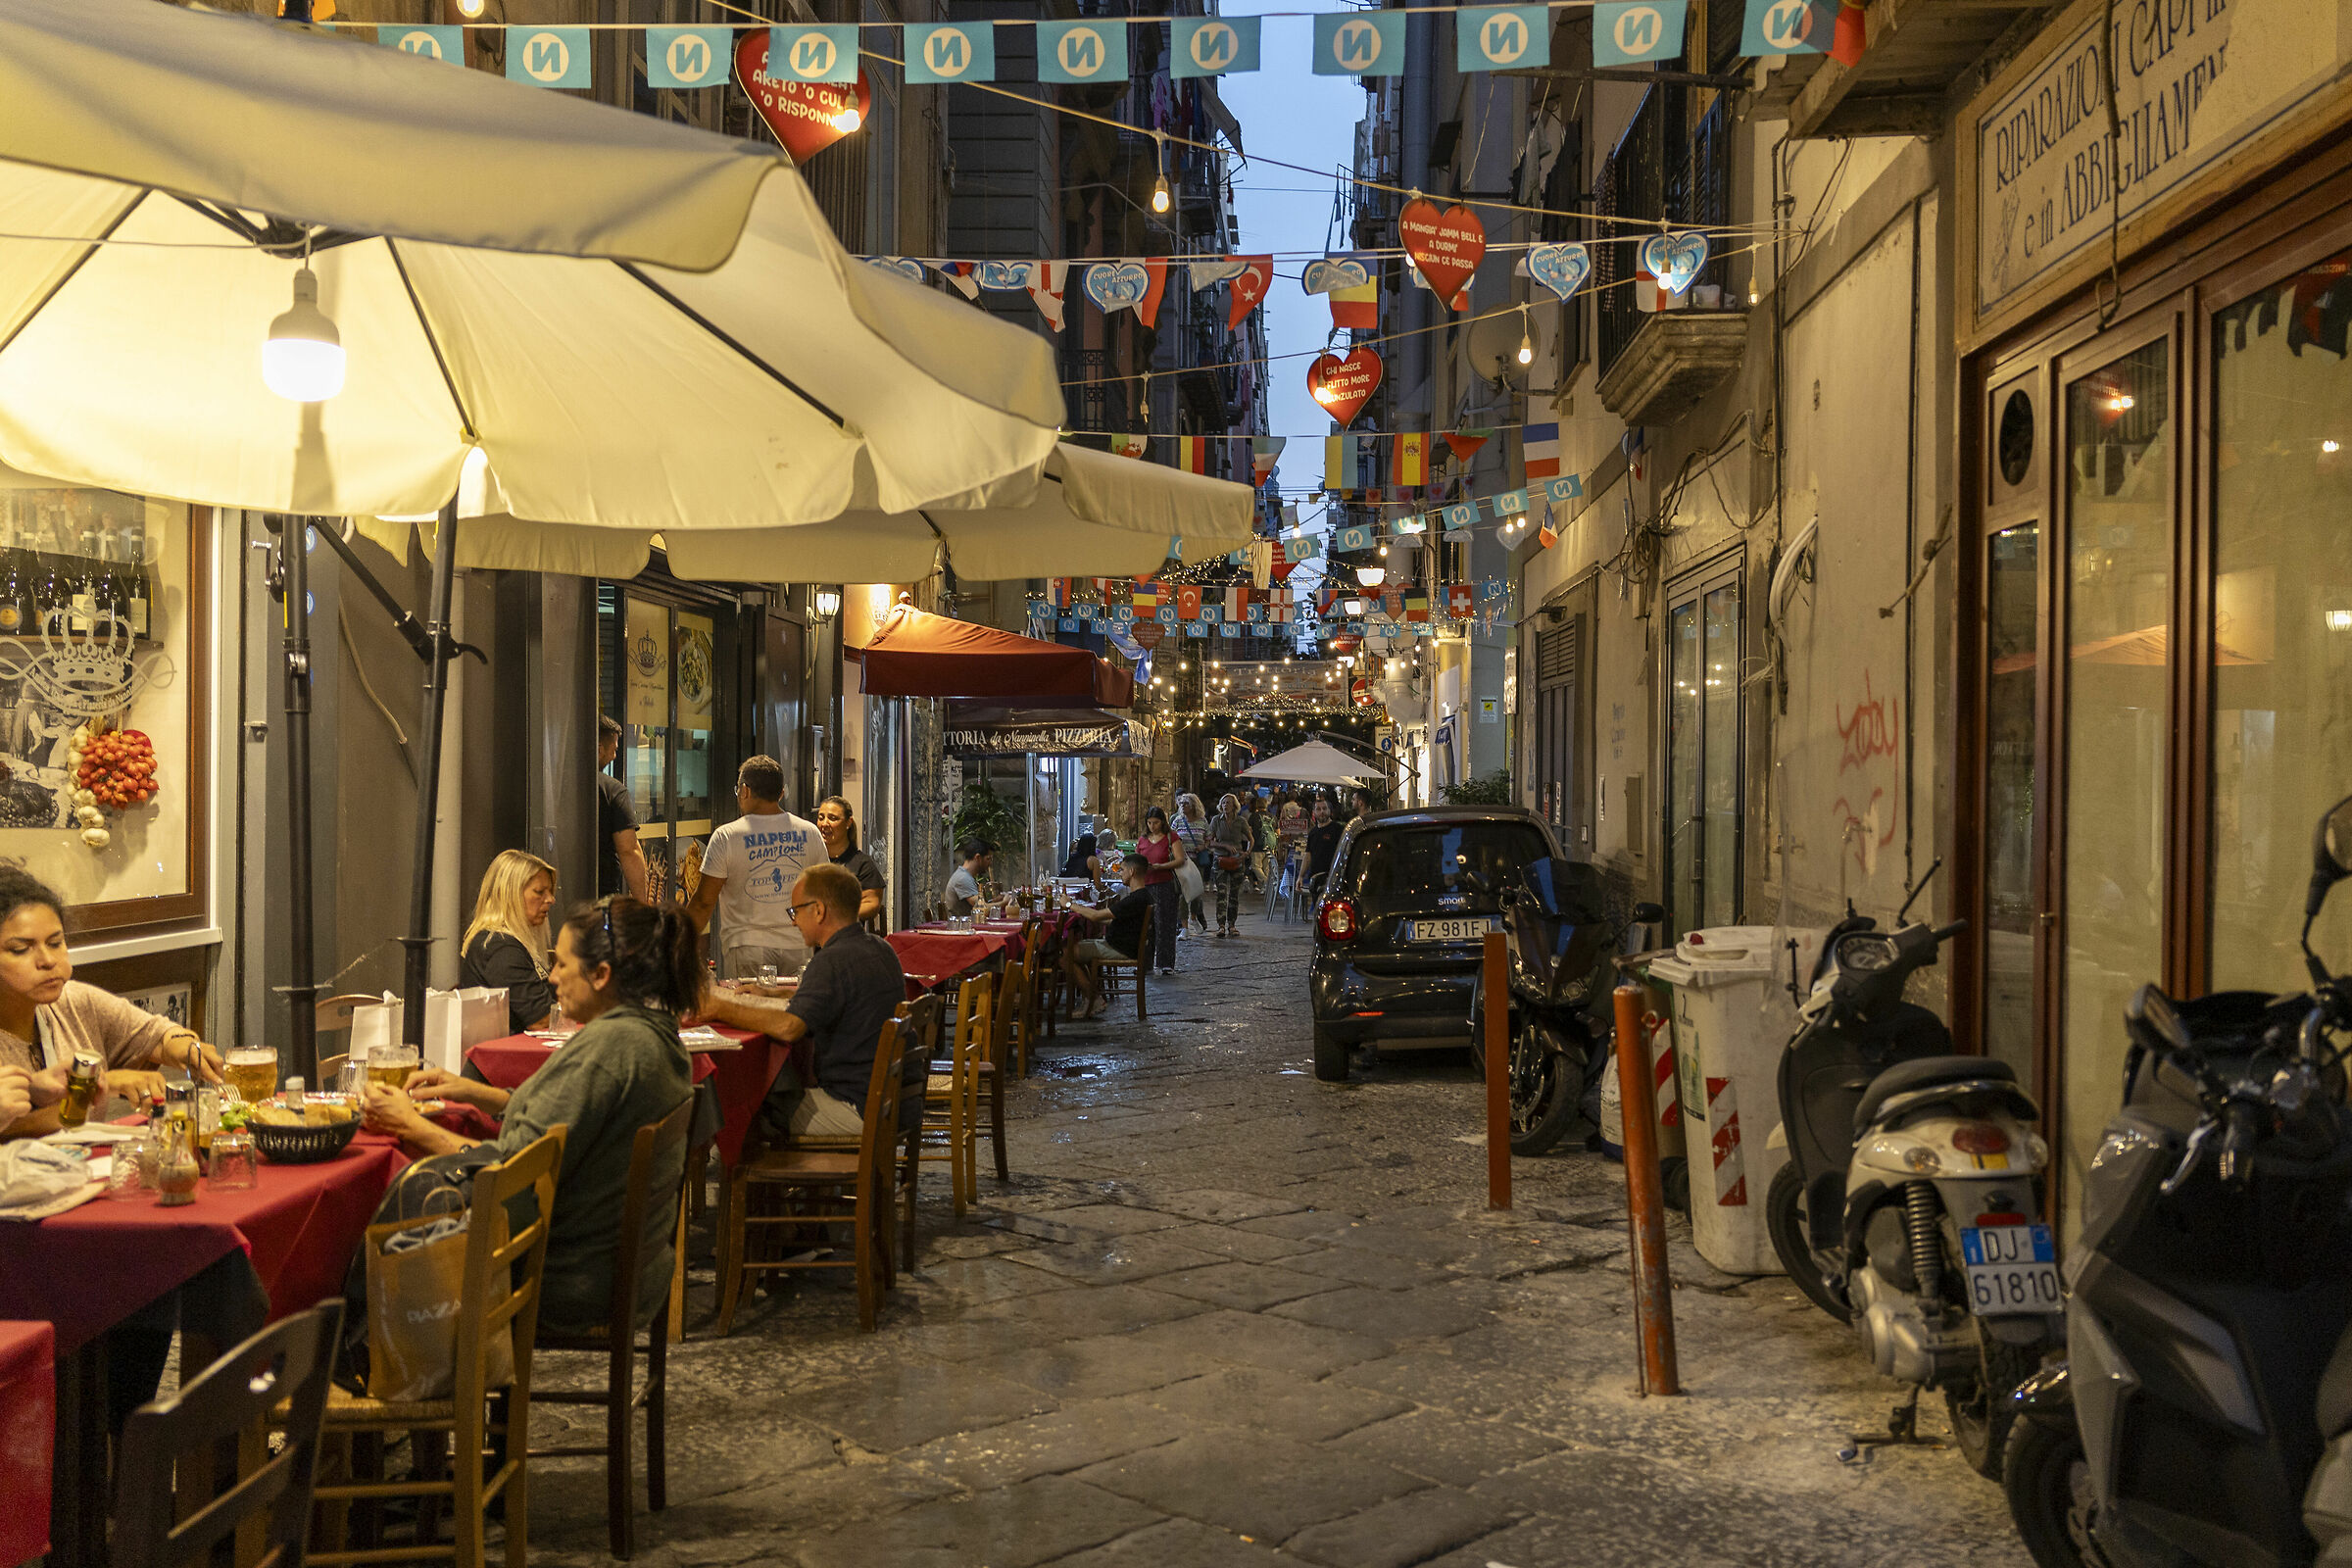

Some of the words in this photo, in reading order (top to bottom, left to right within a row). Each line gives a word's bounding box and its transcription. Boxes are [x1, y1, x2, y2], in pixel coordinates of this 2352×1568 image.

[819, 90, 845, 110] CUL
[1995, 22, 2121, 193] RIPARAZIOI
[1402, 220, 1408, 230] A
[1439, 227, 1460, 240] JAMM
[2024, 214, 2034, 259] e
[2039, 186, 2054, 249] in
[1429, 240, 1434, 249] A
[1652, 242, 1675, 254] CURE
[1671, 241, 1704, 256] AZZURRO
[1442, 256, 1450, 266] CE
[1451, 257, 1474, 270] PASSA
[1536, 252, 1558, 264] CUORE
[1555, 251, 1586, 265] AZZURRO
[1093, 270, 1115, 280] CUORE
[1111, 272, 1145, 283] AZZURRO
[1326, 367, 1337, 375] CHI
[1339, 362, 1361, 373] NASCE
[1350, 374, 1371, 385] MORE
[990, 730, 1002, 746] da
[1054, 728, 1113, 745] PIZZERIA
[744, 830, 808, 849] NAPOLI
[749, 843, 805, 860] CAMPIONE
[1417, 922, 1436, 938] FZ
[1984, 1230, 2018, 1262] DJ
[1974, 1271, 2058, 1305] 61810
